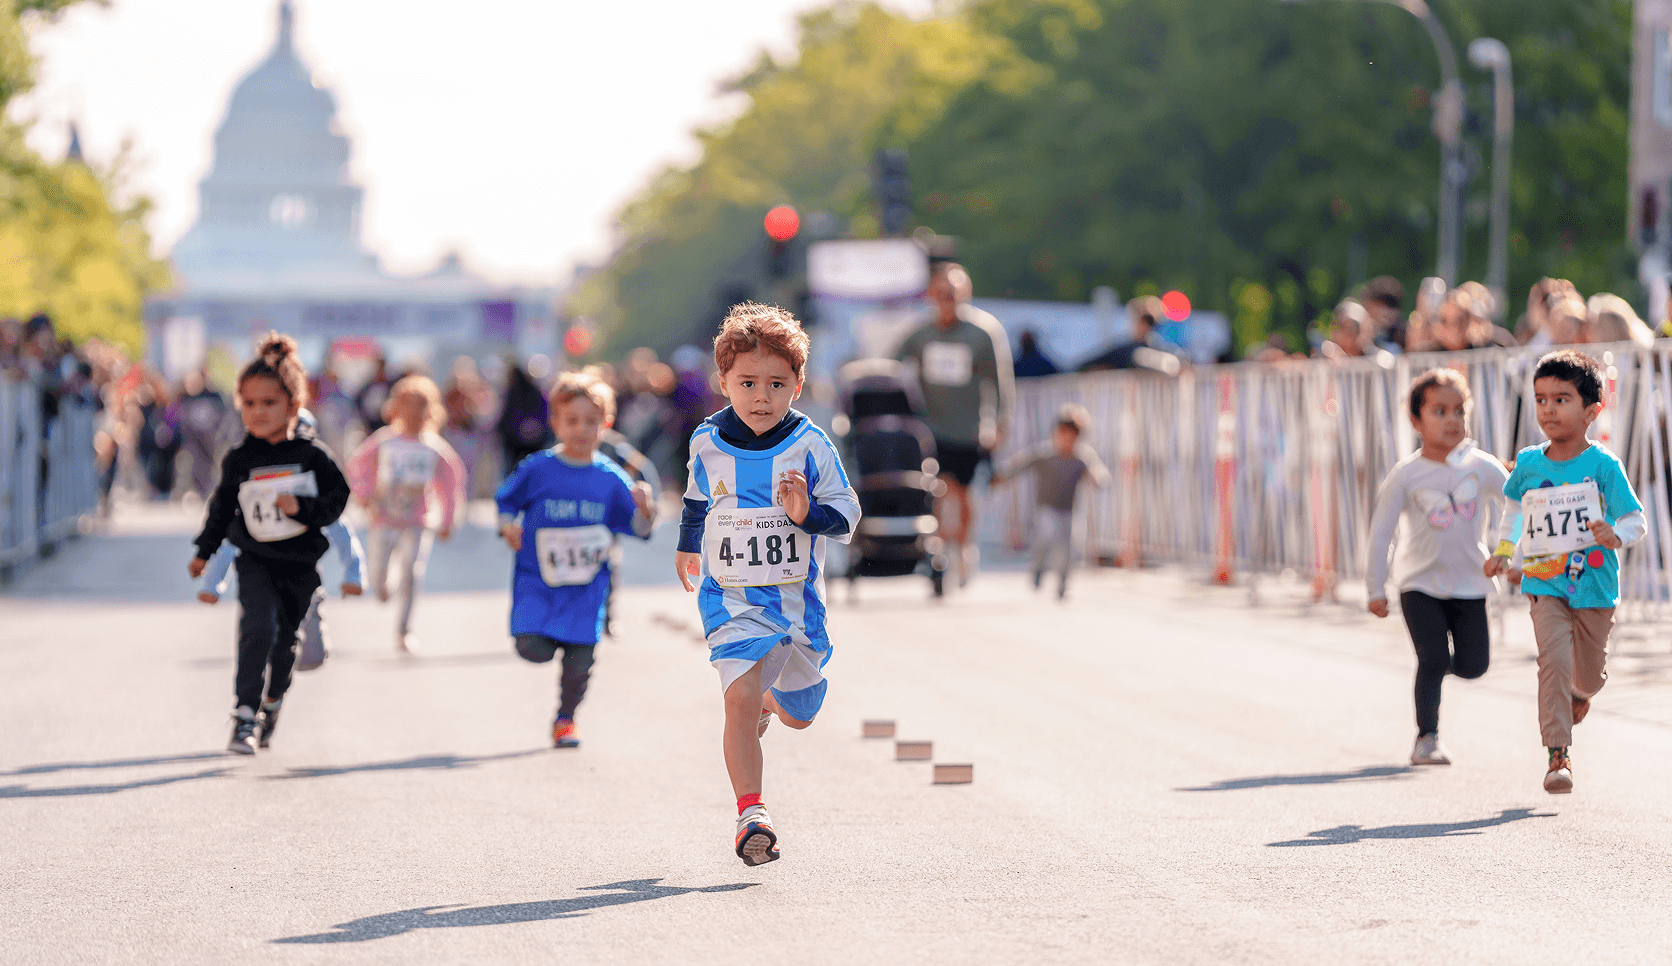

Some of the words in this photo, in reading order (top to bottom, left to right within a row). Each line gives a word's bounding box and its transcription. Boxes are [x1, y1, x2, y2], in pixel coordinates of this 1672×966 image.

[717, 520, 736, 528] every
[736, 518, 753, 527] child
[756, 520, 775, 529] KIDS
[777, 520, 793, 528] DAS
[1527, 507, 1589, 538] 4-175
[719, 532, 800, 567] 4-181
